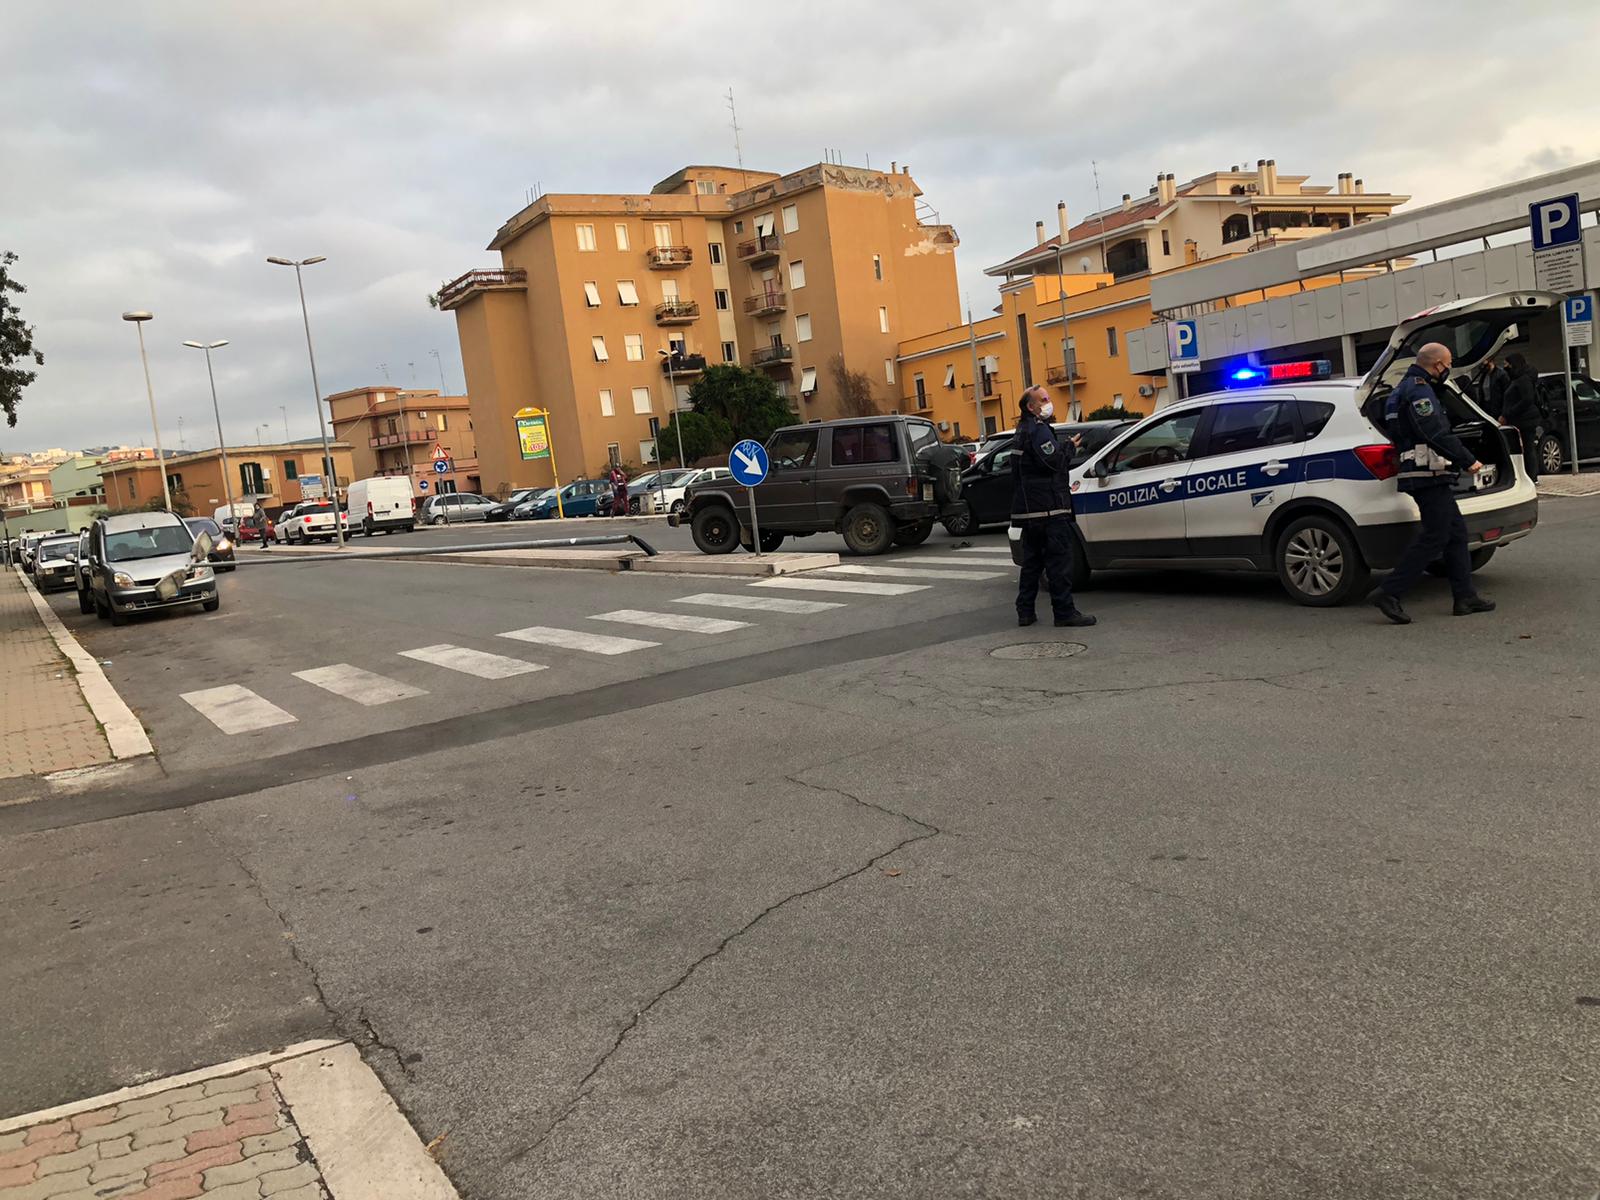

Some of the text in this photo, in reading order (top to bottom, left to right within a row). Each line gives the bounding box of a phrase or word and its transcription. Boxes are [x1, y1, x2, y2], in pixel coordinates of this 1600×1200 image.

[1540, 202, 1570, 245] P
[1571, 299, 1586, 320] P
[1175, 324, 1193, 357] P
[1109, 471, 1247, 507] POLIZIA LOCALE
